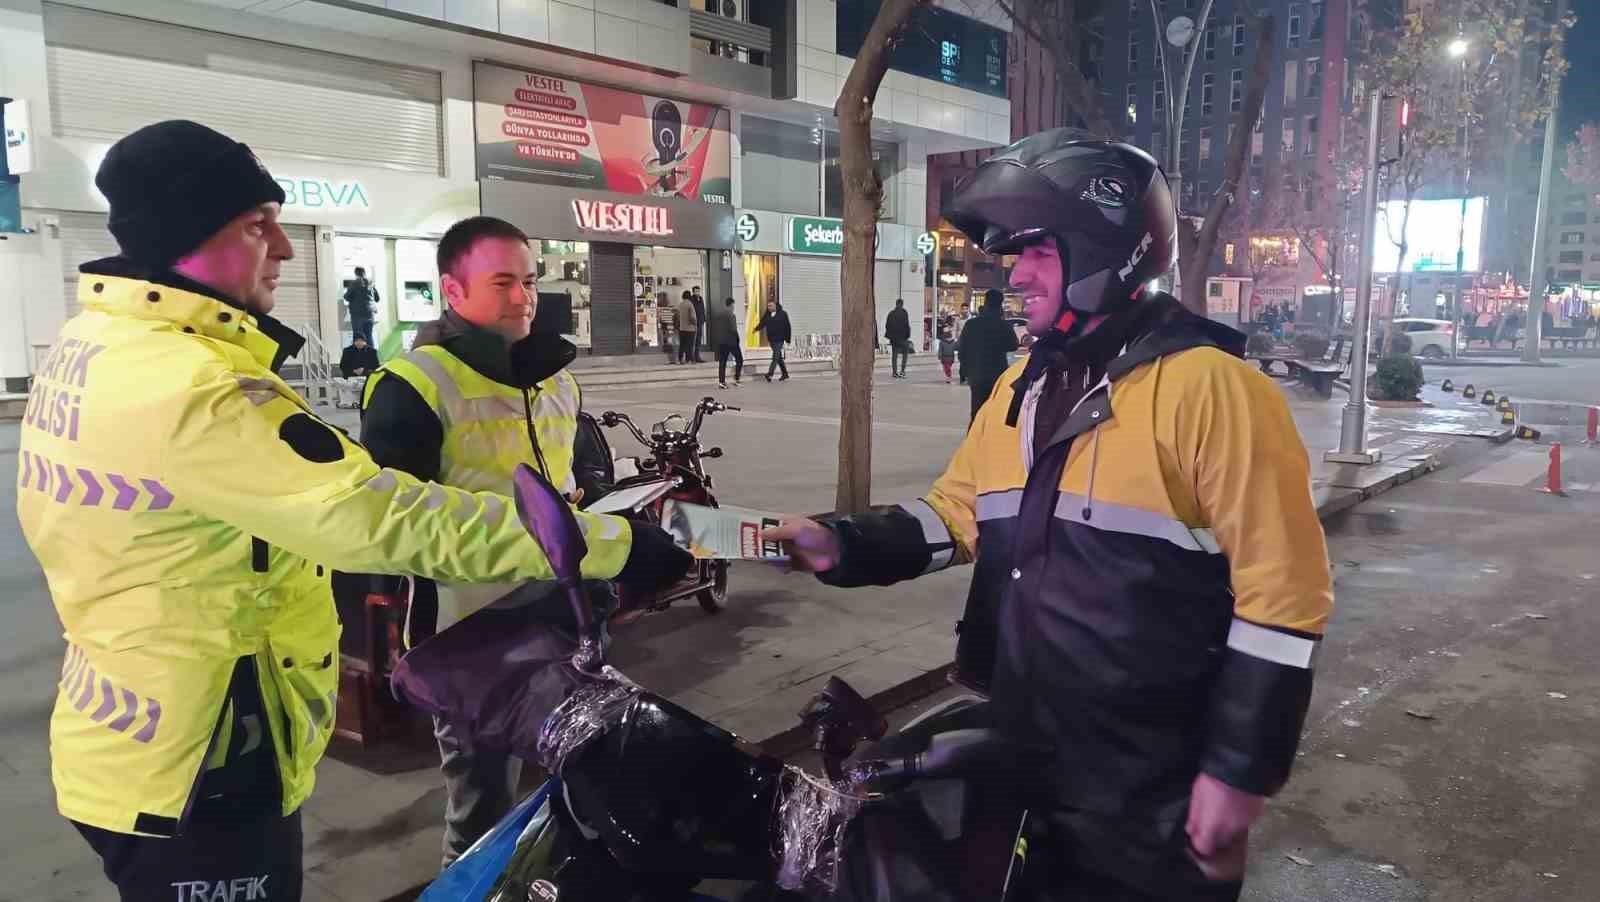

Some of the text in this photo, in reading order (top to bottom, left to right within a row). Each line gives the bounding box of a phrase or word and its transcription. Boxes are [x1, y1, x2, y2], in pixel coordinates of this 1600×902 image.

[526, 74, 567, 93] VESTEL
[505, 120, 587, 144] DÜNYA YOLLARINDA
[518, 144, 529, 154] VE
[275, 177, 369, 208] BBVA
[703, 194, 727, 205] VESTEL
[571, 199, 674, 236] VESTEL
[1118, 232, 1153, 282] NCR
